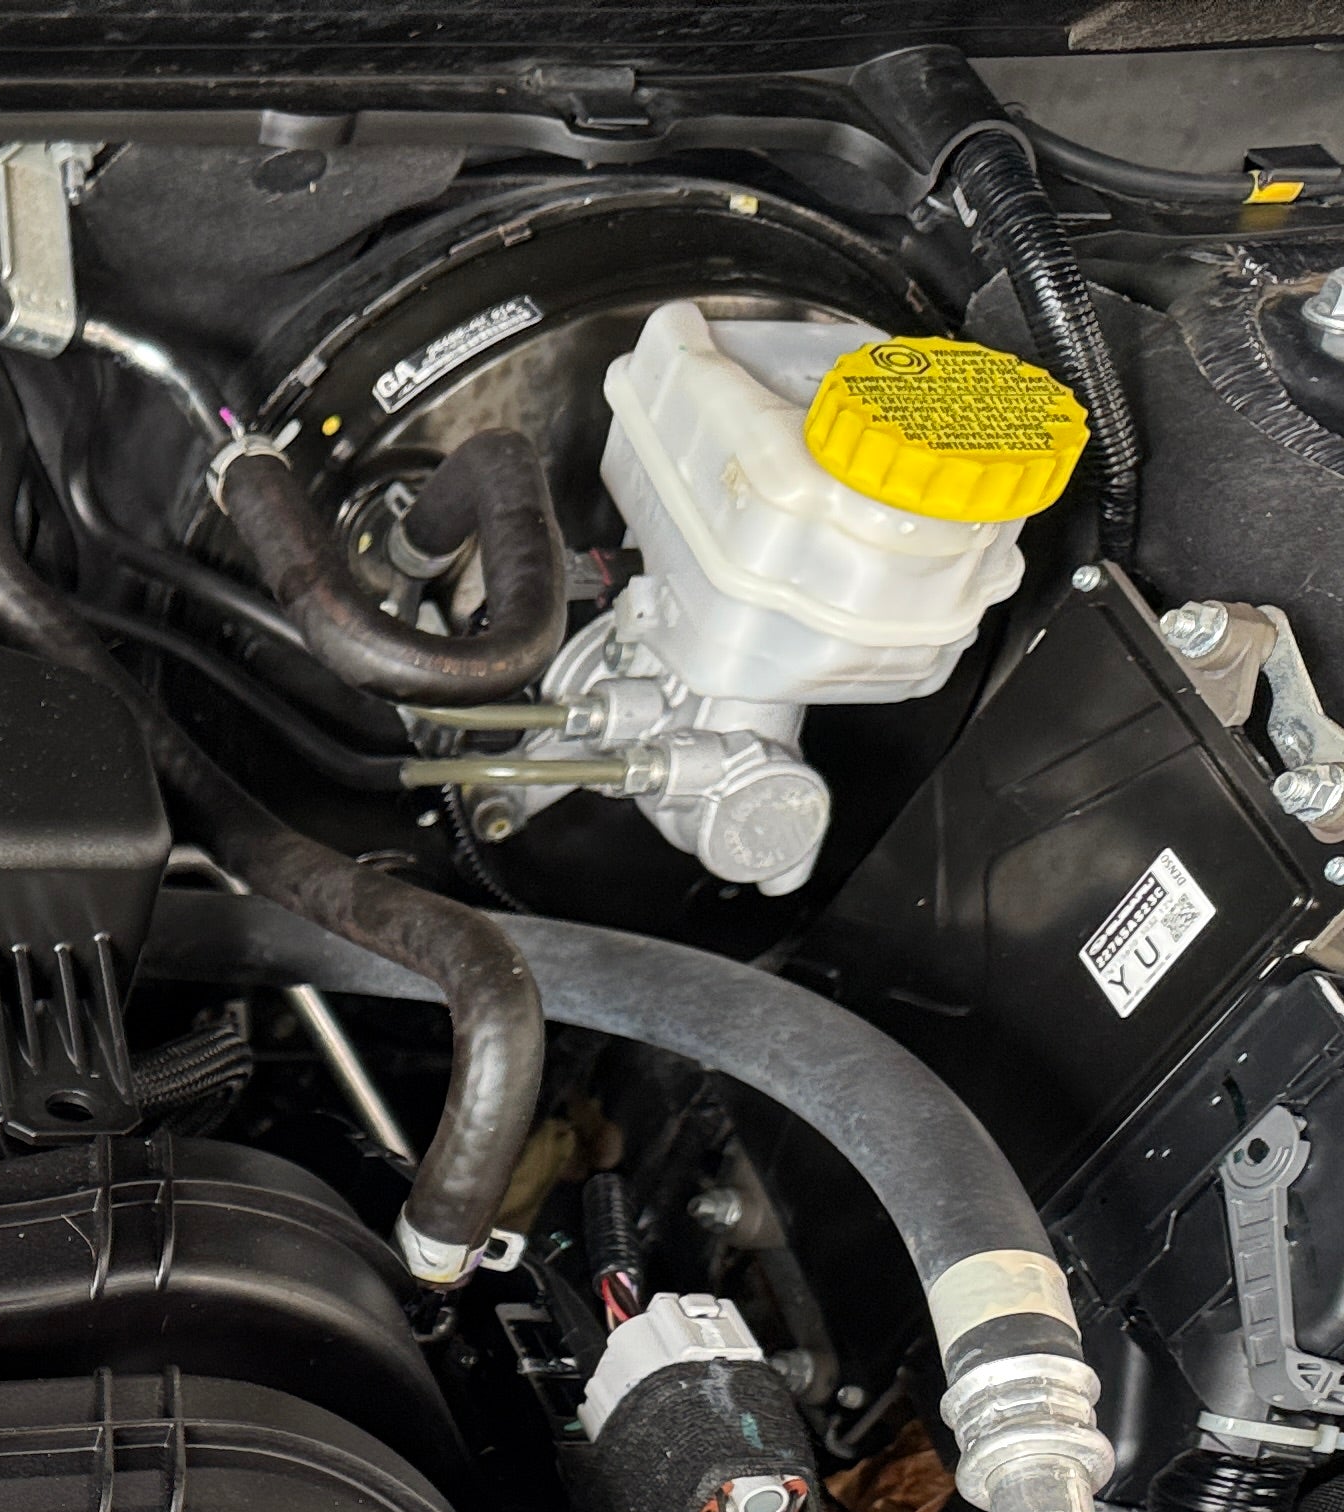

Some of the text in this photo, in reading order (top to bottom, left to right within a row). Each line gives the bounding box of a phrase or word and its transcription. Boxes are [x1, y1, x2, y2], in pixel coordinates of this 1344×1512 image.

[1161, 854, 1187, 886] DENSO
[1108, 963, 1131, 996] Y
[1134, 936, 1160, 968] U
